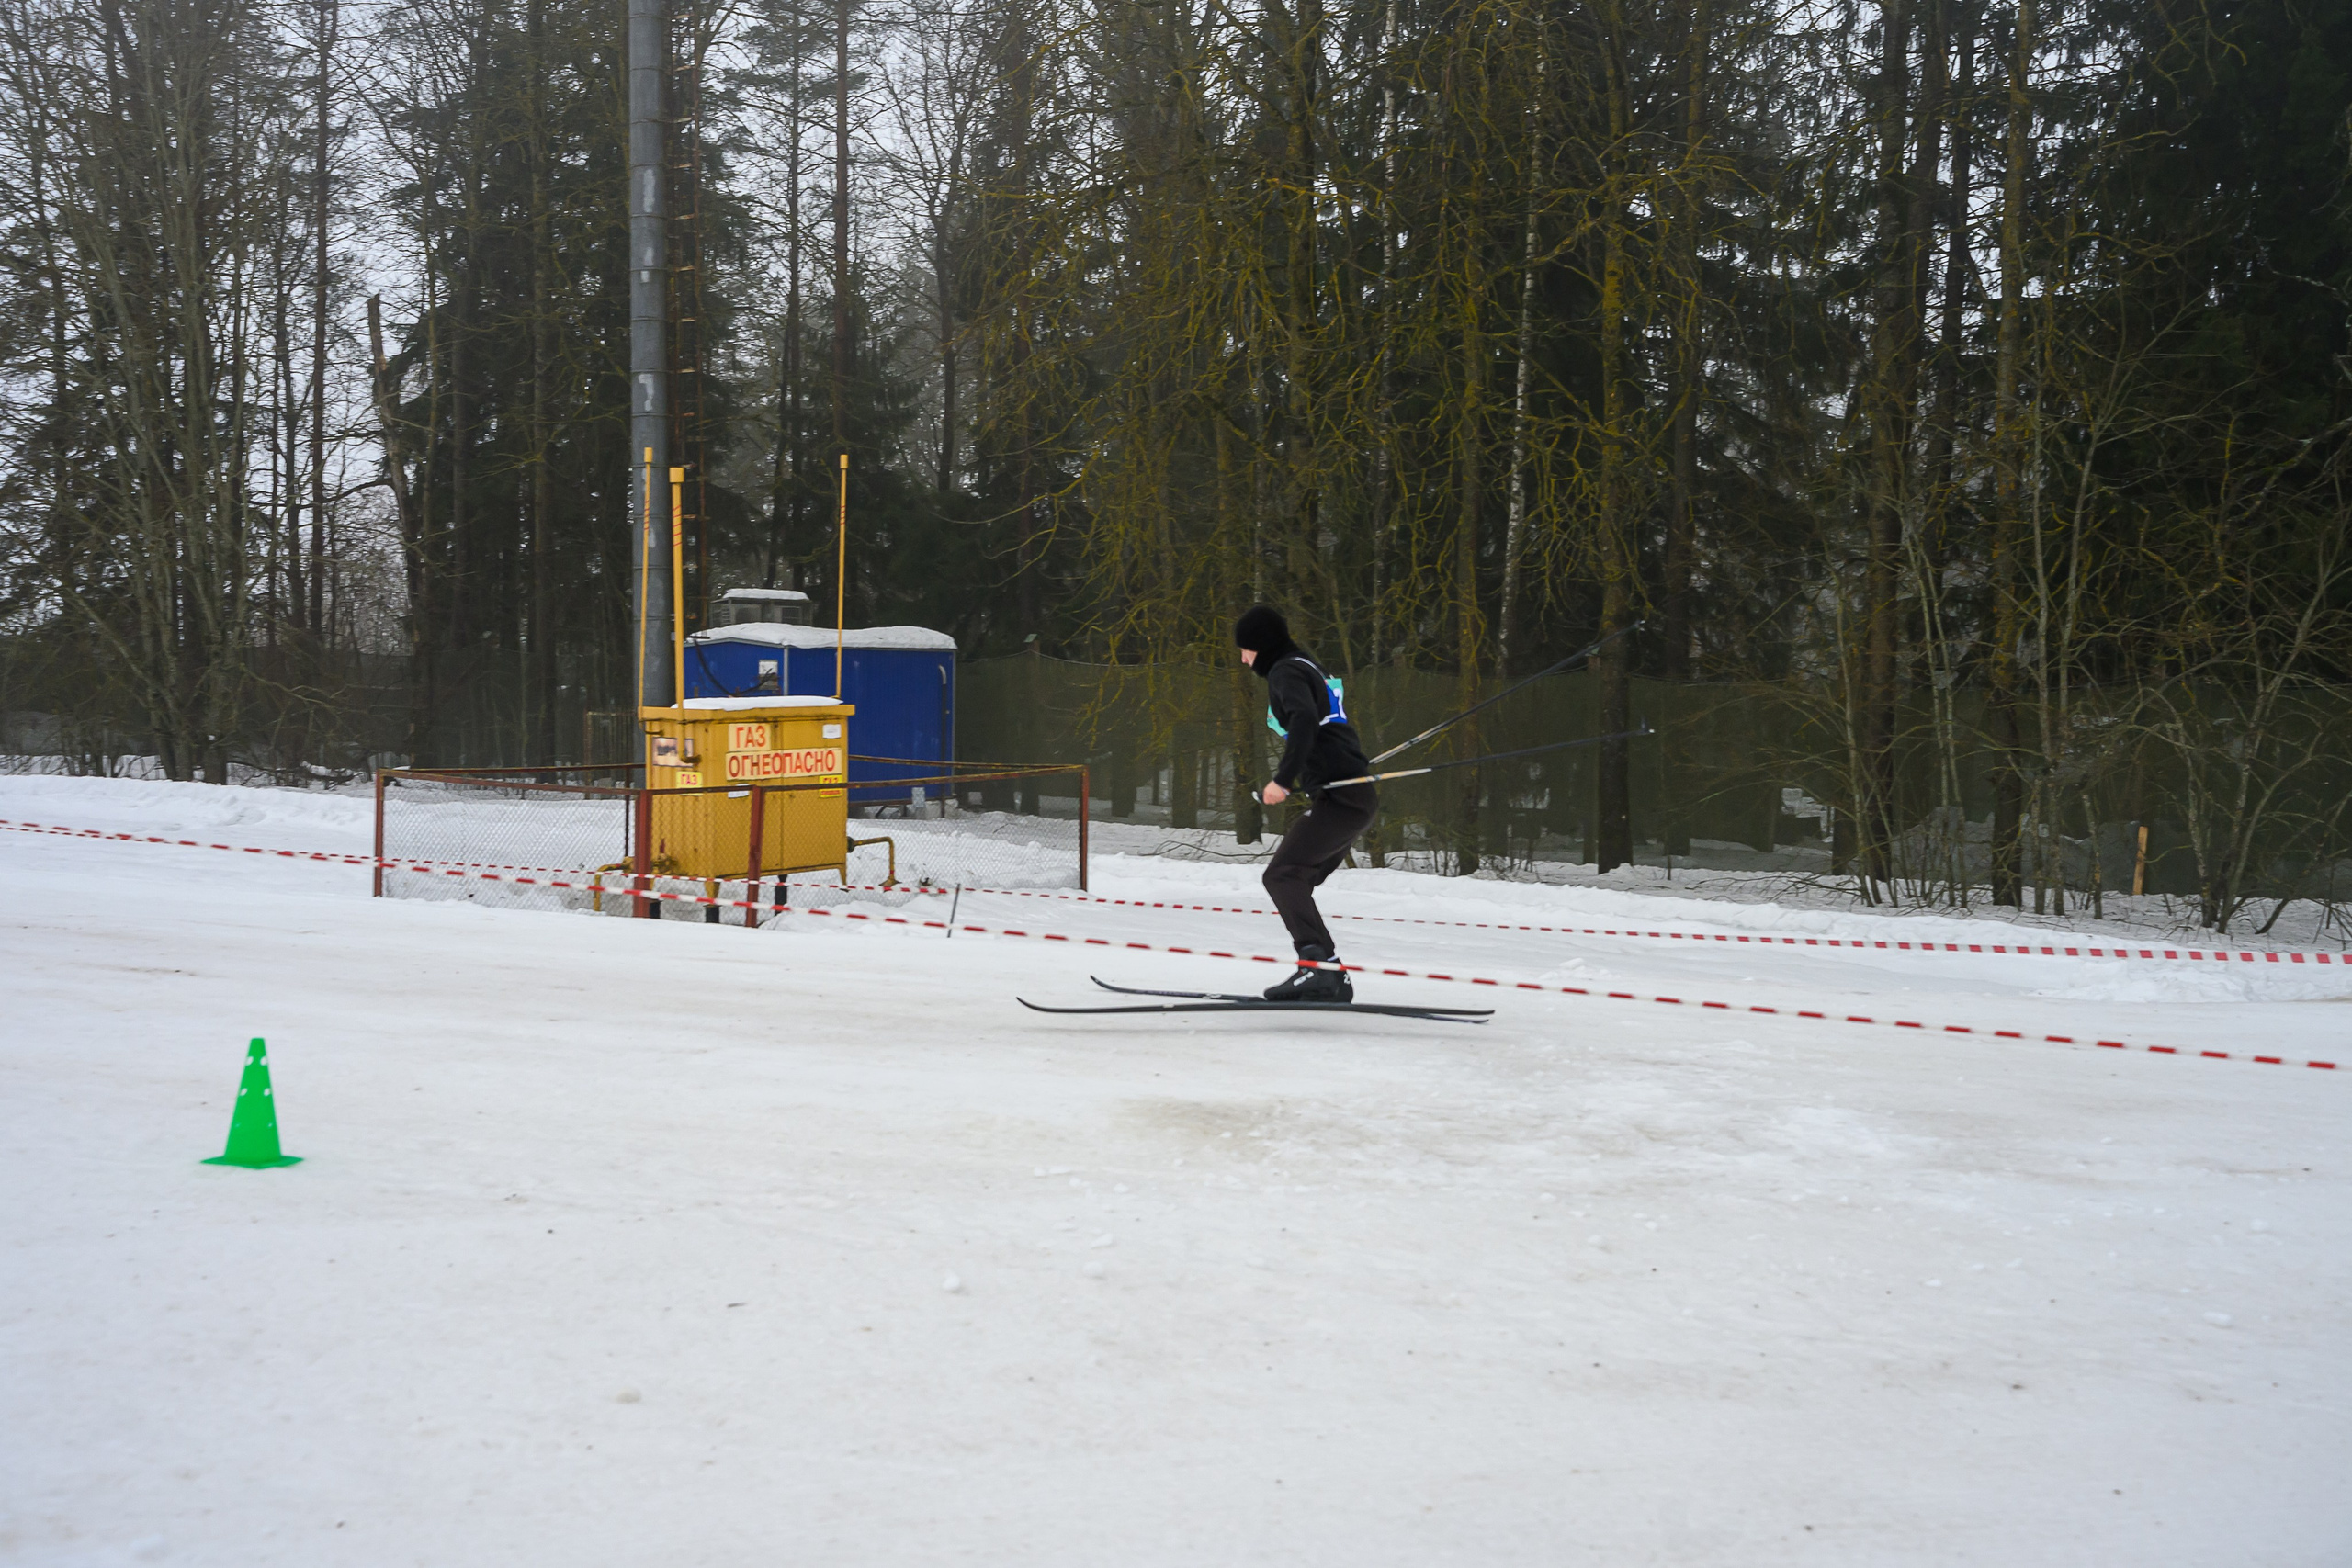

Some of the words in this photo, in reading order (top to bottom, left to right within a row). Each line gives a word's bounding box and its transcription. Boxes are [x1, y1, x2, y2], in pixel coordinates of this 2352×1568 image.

[736, 725, 766, 749] ГАЗ
[728, 750, 836, 778] ОГНЕОПАСНО
[680, 773, 698, 786] ГАЗ
